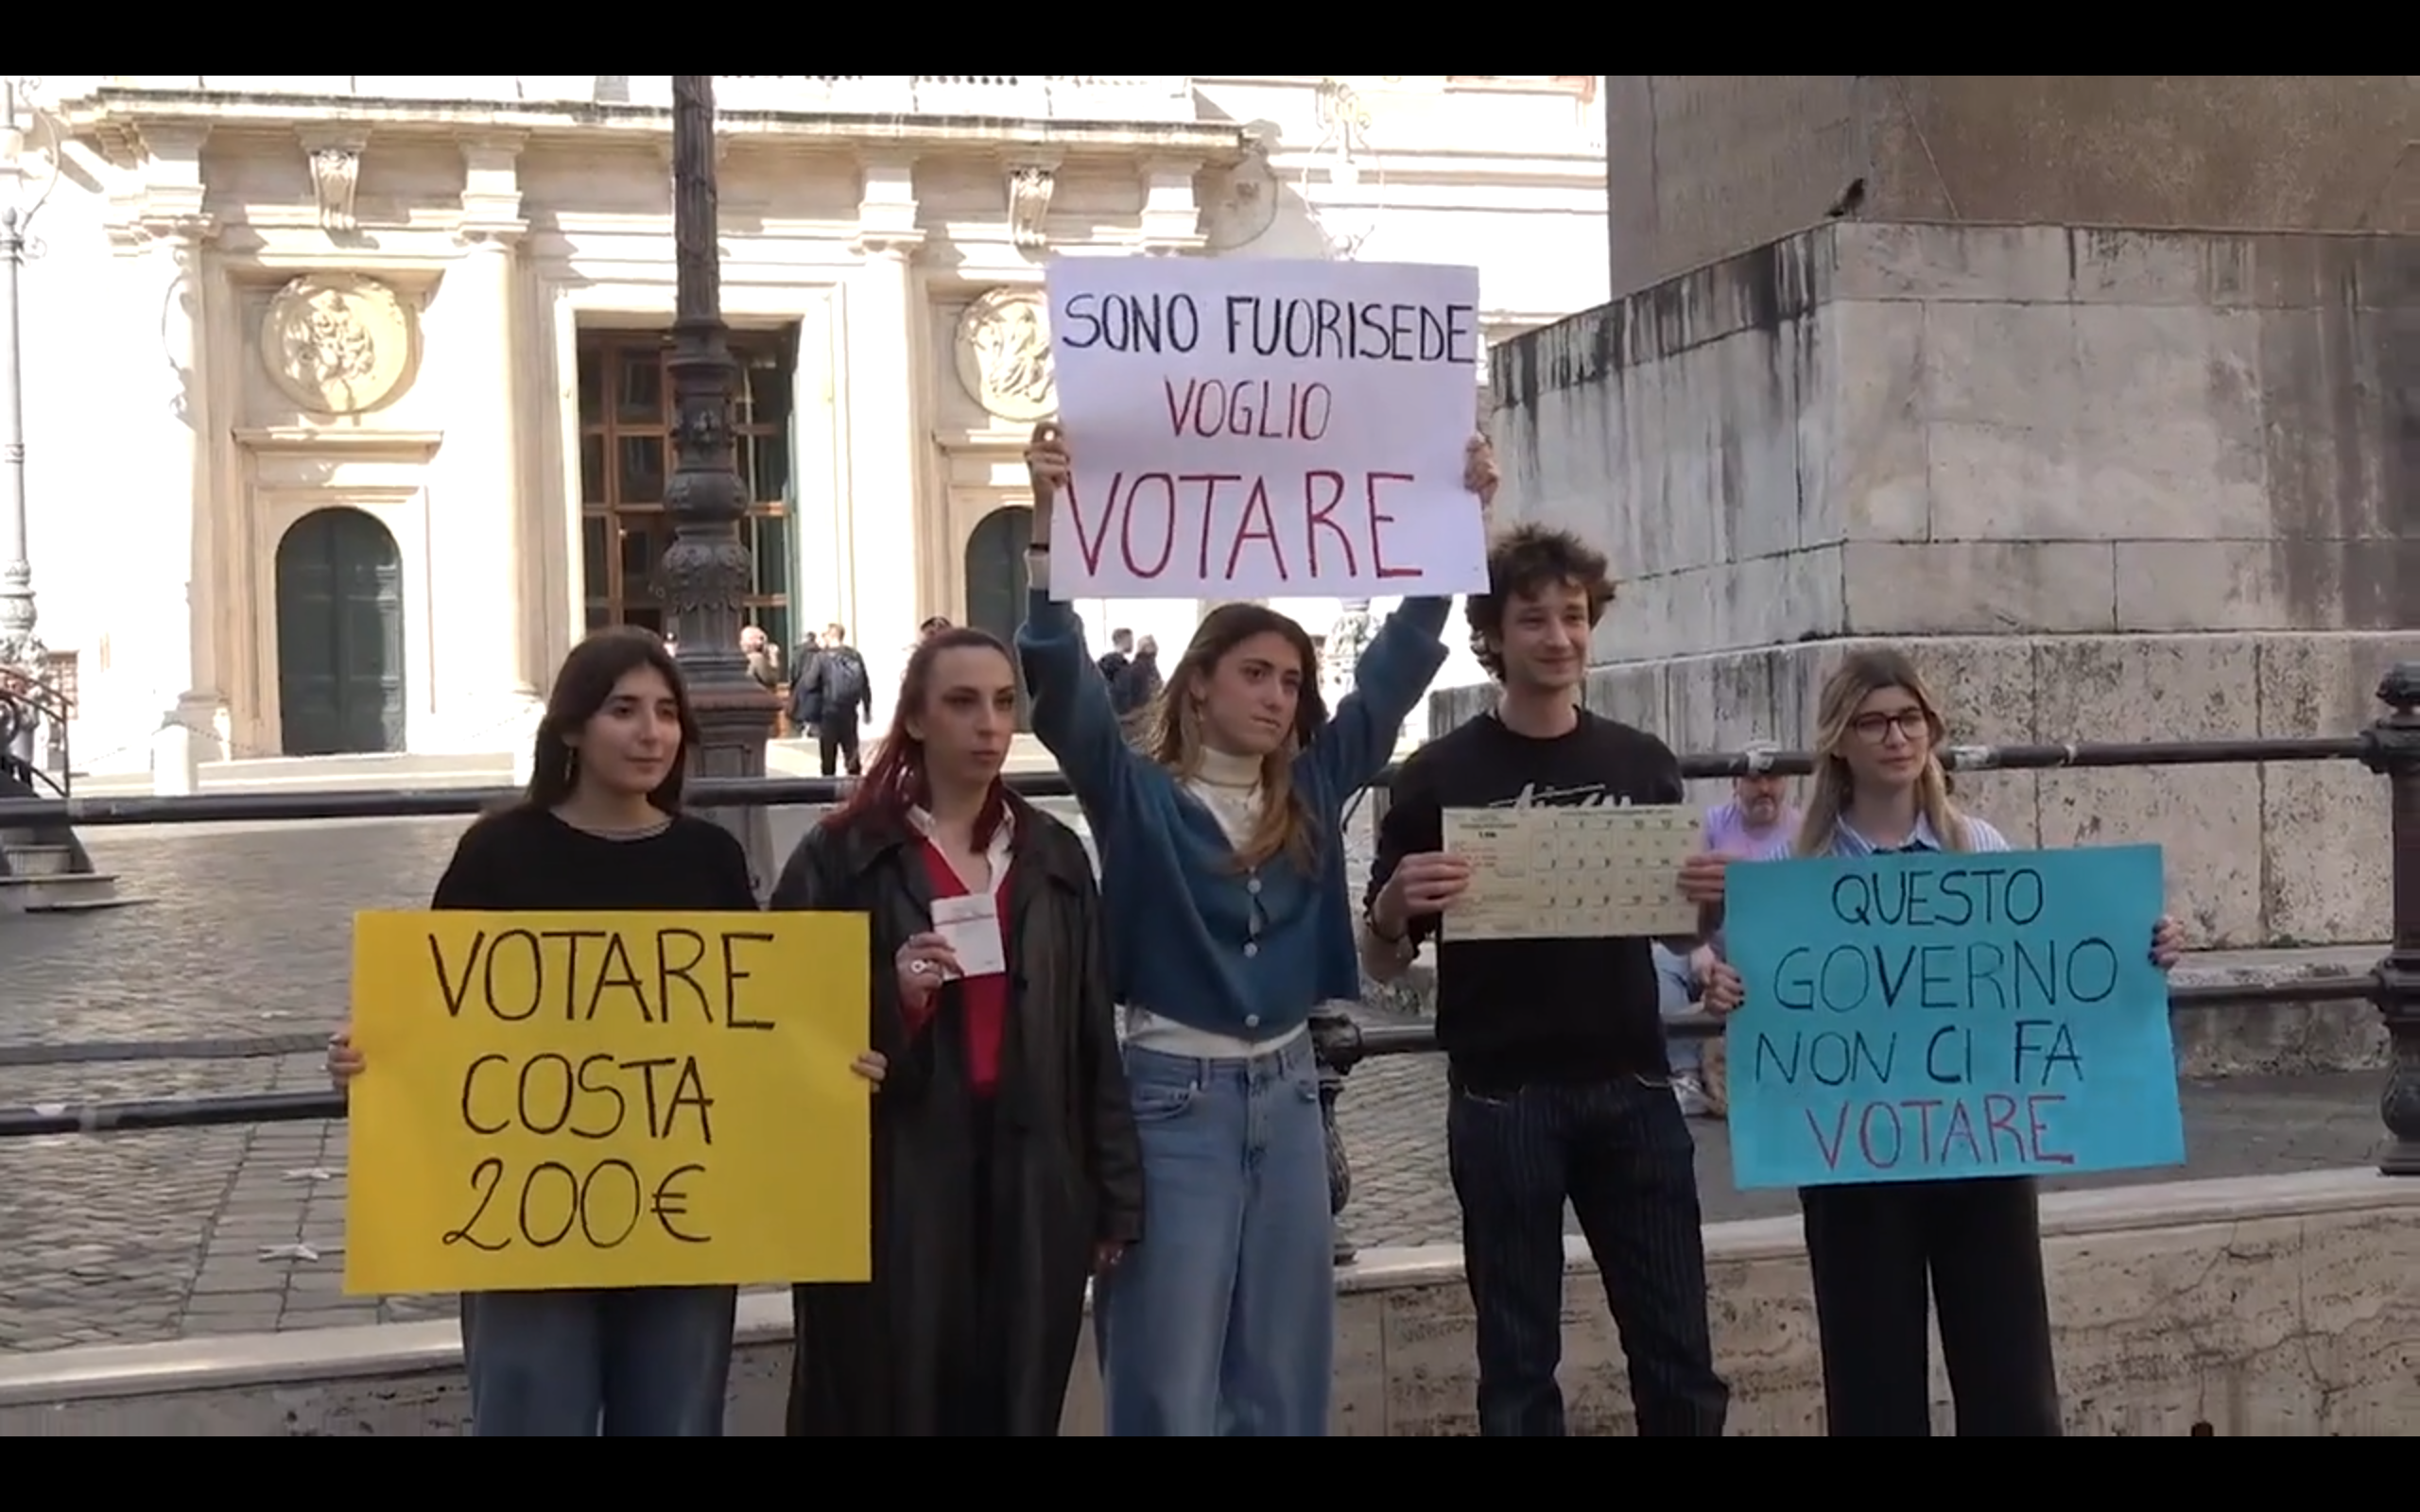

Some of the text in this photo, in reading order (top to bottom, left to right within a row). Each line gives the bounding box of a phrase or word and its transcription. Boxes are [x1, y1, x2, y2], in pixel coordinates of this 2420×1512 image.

[1062, 292, 1476, 365] SONO FUORISEDE
[1164, 374, 1331, 440] VOGLIO
[1066, 470, 1423, 581] VOTARE
[1832, 868, 2044, 926] QUESTO
[428, 928, 775, 1030] VOTARE
[1773, 937, 2118, 1012] GOVERNO
[1755, 1020, 2083, 1086] NON CI FA
[462, 1053, 715, 1144] COSTA
[1806, 1093, 2075, 1171] VOTARE
[442, 1158, 711, 1250] 200€
